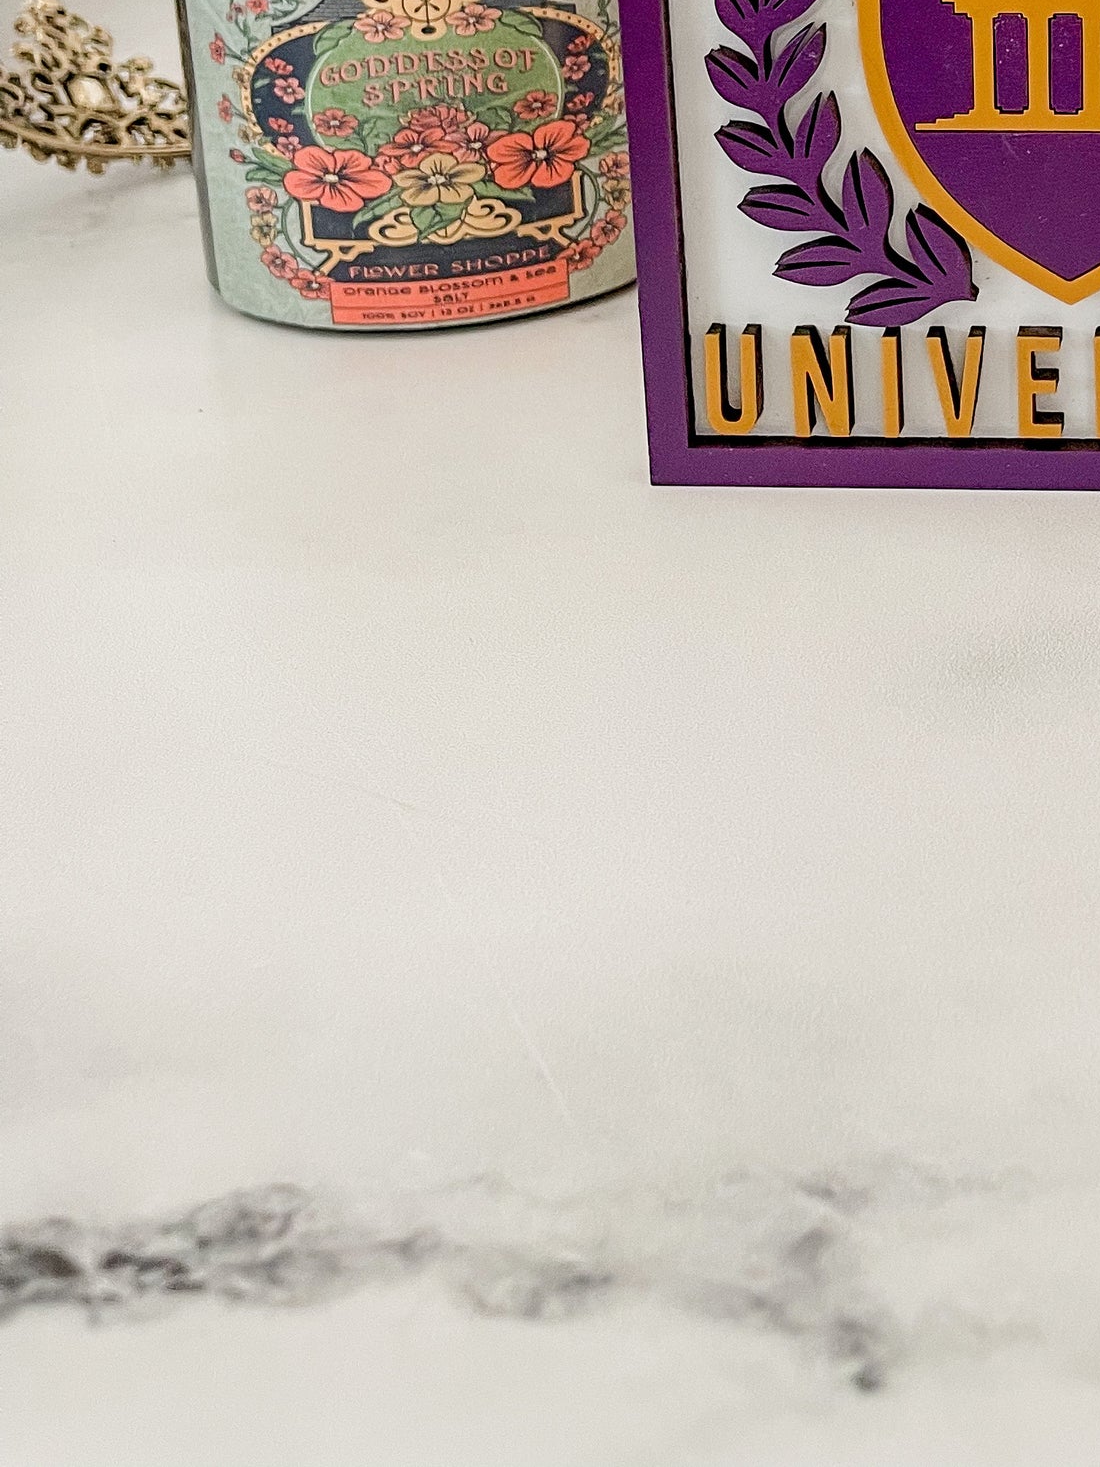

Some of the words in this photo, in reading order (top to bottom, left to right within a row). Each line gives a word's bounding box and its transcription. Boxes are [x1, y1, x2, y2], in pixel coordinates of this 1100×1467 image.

[320, 47, 490, 85] GODDESS
[494, 47, 539, 72] OF
[362, 72, 509, 108] SPRING
[349, 263, 440, 279] FLOWER
[451, 245, 551, 273] SHOPPE
